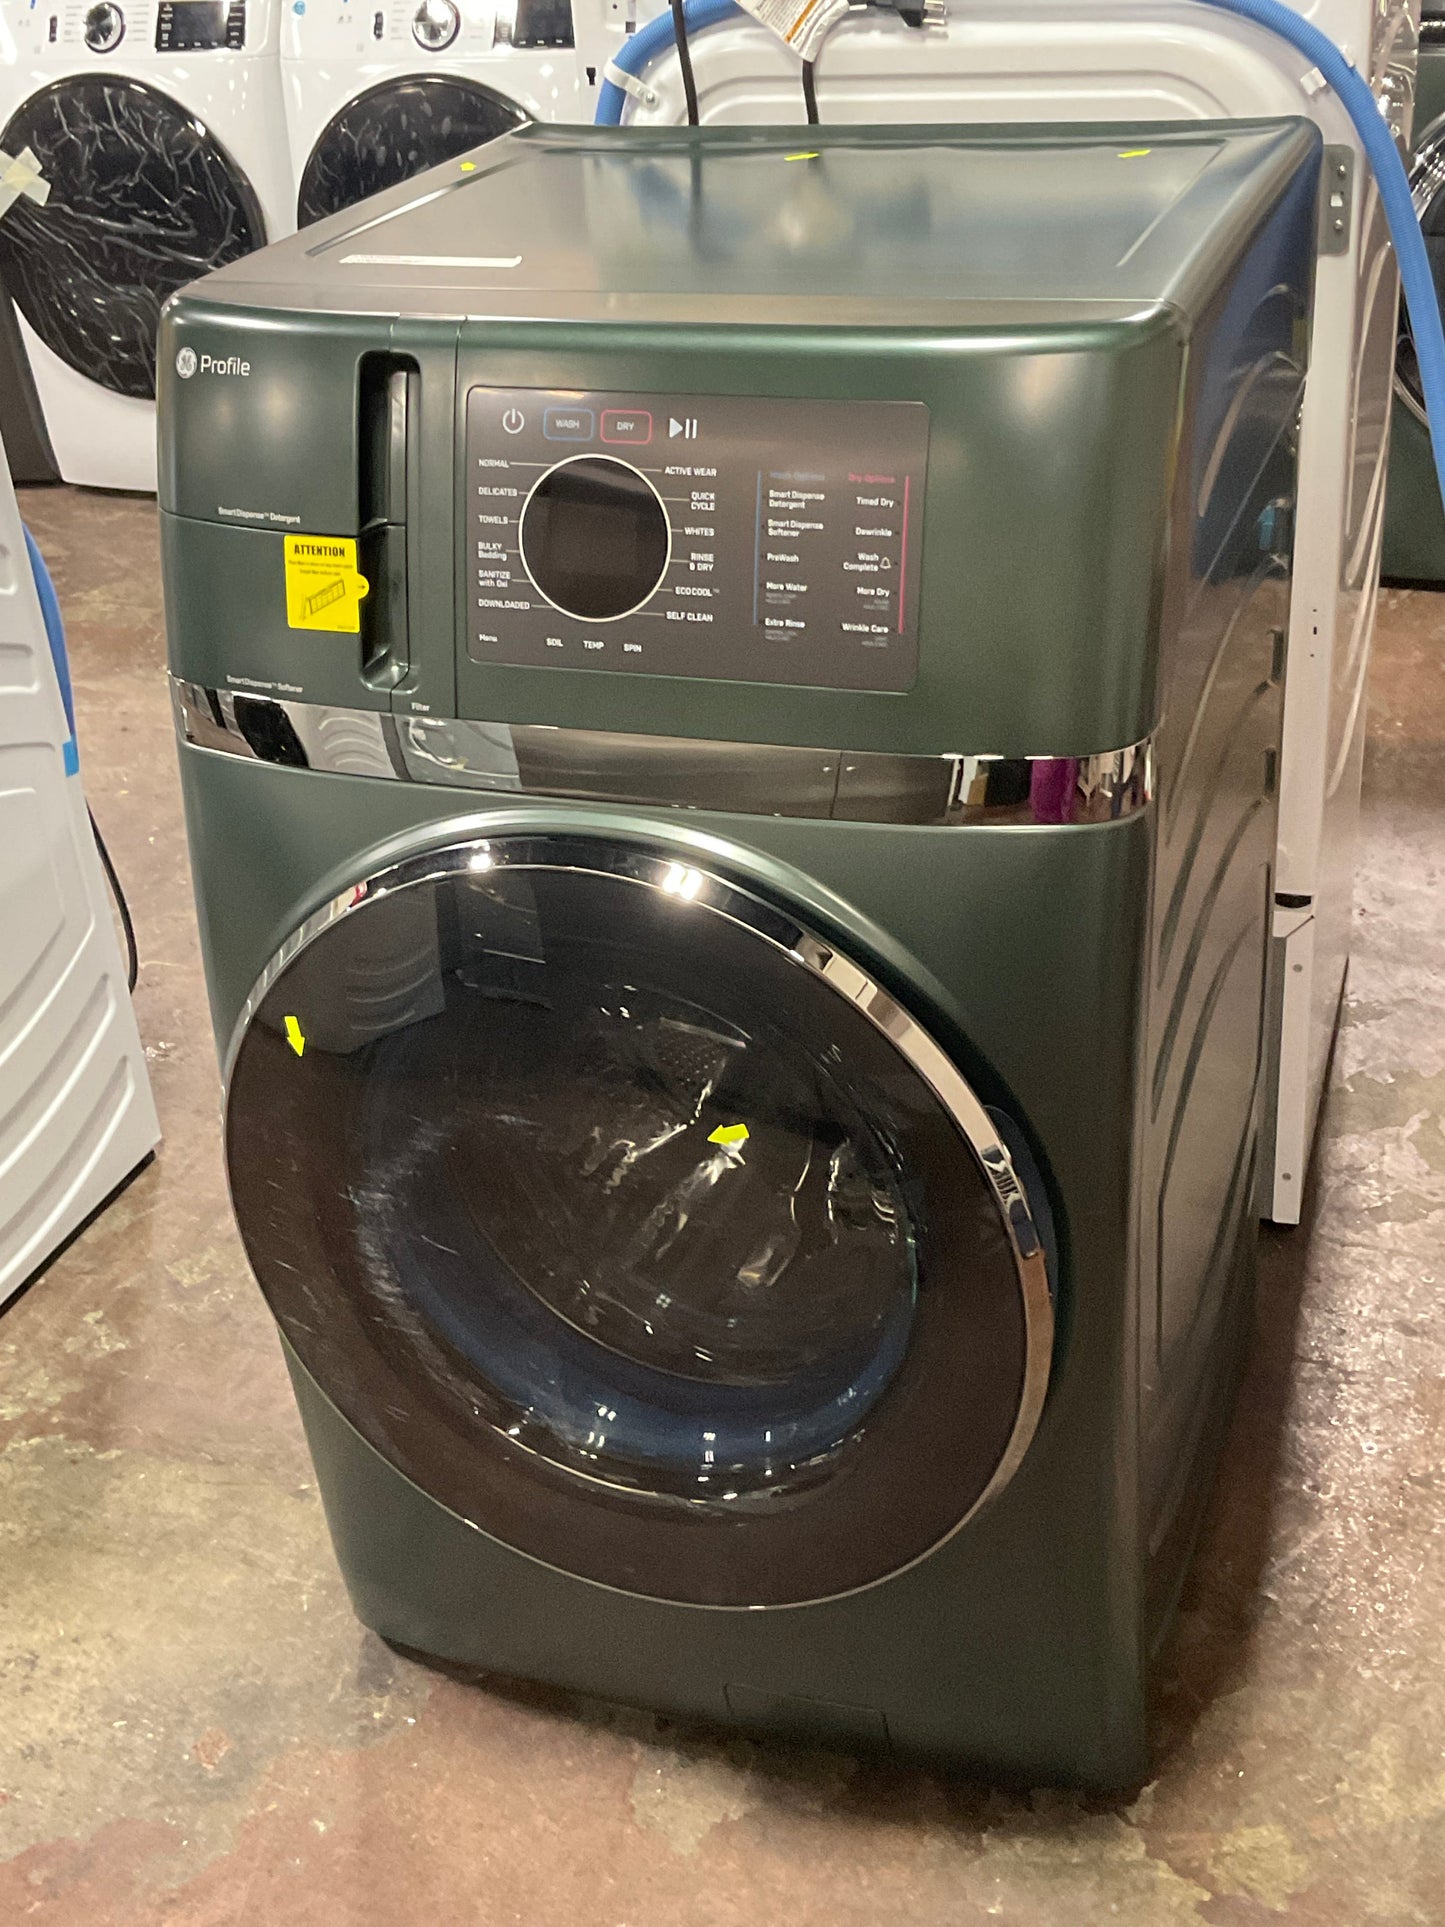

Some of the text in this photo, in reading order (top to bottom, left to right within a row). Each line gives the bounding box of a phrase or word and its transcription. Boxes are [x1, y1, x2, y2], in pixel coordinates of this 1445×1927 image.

[200, 354, 251, 376] Profile
[555, 419, 580, 429] WASH
[616, 421, 635, 431] DRY
[478, 459, 510, 468] NORMAL
[665, 466, 717, 477] ACTIVE WEAR
[478, 486, 518, 497] DELICATES
[691, 491, 715, 501] QUICK
[769, 490, 825, 501] Smart Dispense
[690, 501, 716, 511] CYCLE
[769, 500, 806, 510] Detergent
[856, 496, 895, 508] Timed Dry
[478, 514, 509, 525] TOWELS
[767, 519, 824, 530] Smart Dispense
[684, 527, 715, 537] WHITES
[768, 528, 800, 537] Softener
[855, 527, 893, 537] Dewrinkle
[294, 544, 346, 557] ATTENTION
[478, 541, 503, 551] BULKY
[478, 550, 507, 562] Bedding
[690, 552, 715, 562] RINSE
[767, 553, 800, 563] PreWash
[857, 552, 880, 562] Wash
[697, 563, 714, 572] DRY
[843, 561, 879, 572] Complete
[478, 569, 511, 580] SANITIZE
[479, 579, 509, 588] with Oxi
[766, 582, 808, 592] More Water
[857, 587, 891, 598] More Dry
[478, 598, 531, 610] DOWNLOADED
[666, 611, 714, 622] SELF CLEAN
[765, 618, 806, 629] Extra Rinse
[841, 622, 889, 634] Wrinkle Care
[479, 634, 498, 643] Menu
[546, 637, 564, 648] SOIL
[583, 640, 605, 650] TEMP
[623, 643, 643, 653] SPIN
